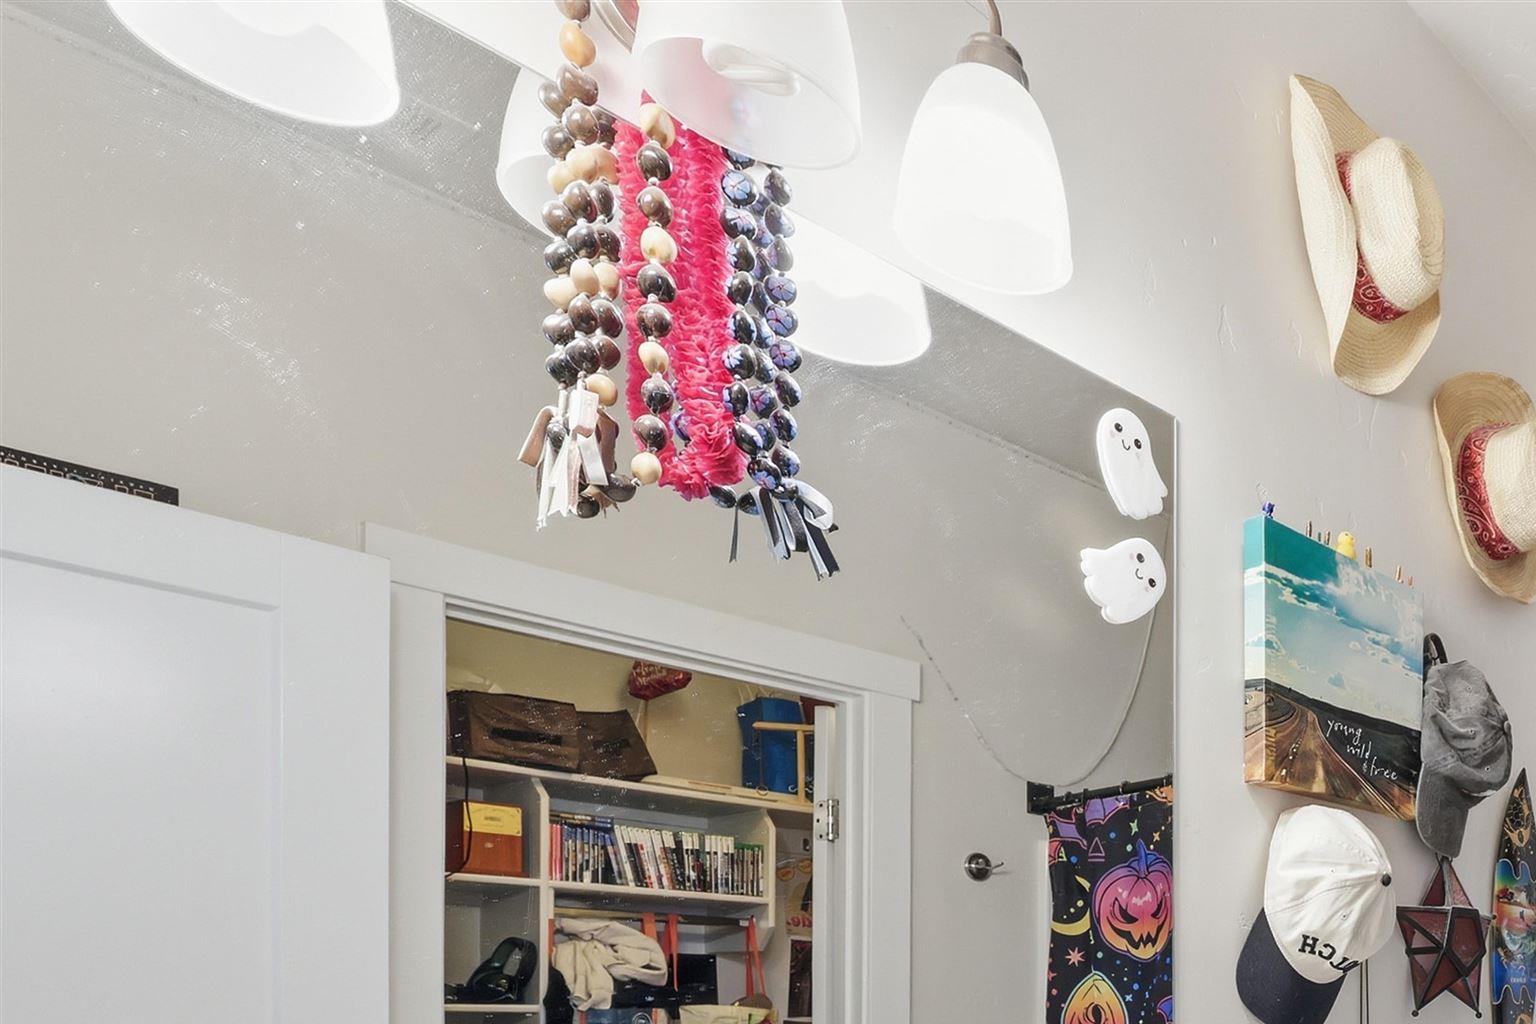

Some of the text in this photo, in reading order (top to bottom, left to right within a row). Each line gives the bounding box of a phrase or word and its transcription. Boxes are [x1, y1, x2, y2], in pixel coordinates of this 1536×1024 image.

[1326, 720, 1362, 746] young
[1346, 741, 1372, 759] wild
[1369, 756, 1398, 780] free
